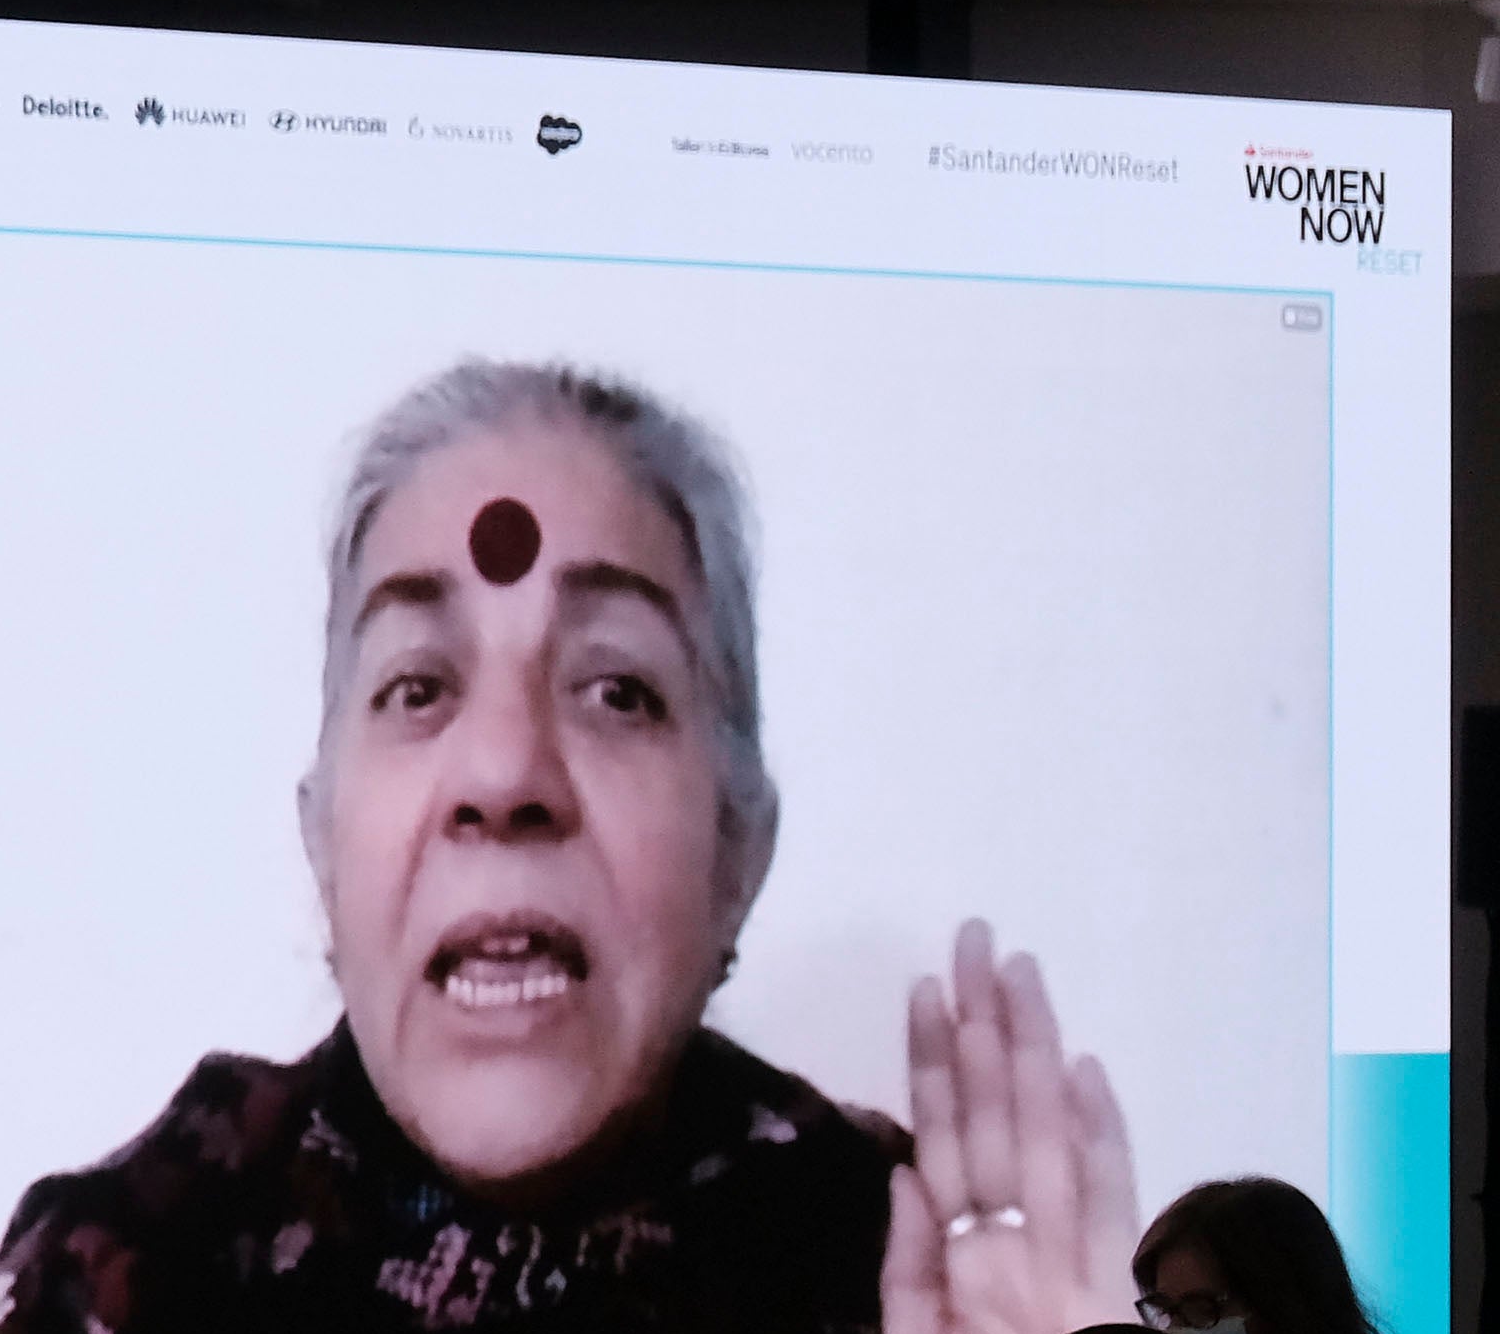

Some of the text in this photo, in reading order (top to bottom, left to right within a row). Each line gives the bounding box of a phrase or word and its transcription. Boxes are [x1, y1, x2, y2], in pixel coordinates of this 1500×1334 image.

[172, 108, 245, 128] HUAWEI
[305, 115, 387, 134] HYUNDAI
[929, 143, 1179, 183] #SantanderWONReset
[1245, 164, 1385, 205] WOMEN
[1301, 207, 1385, 244] NOW
[1357, 248, 1422, 275] RESET
